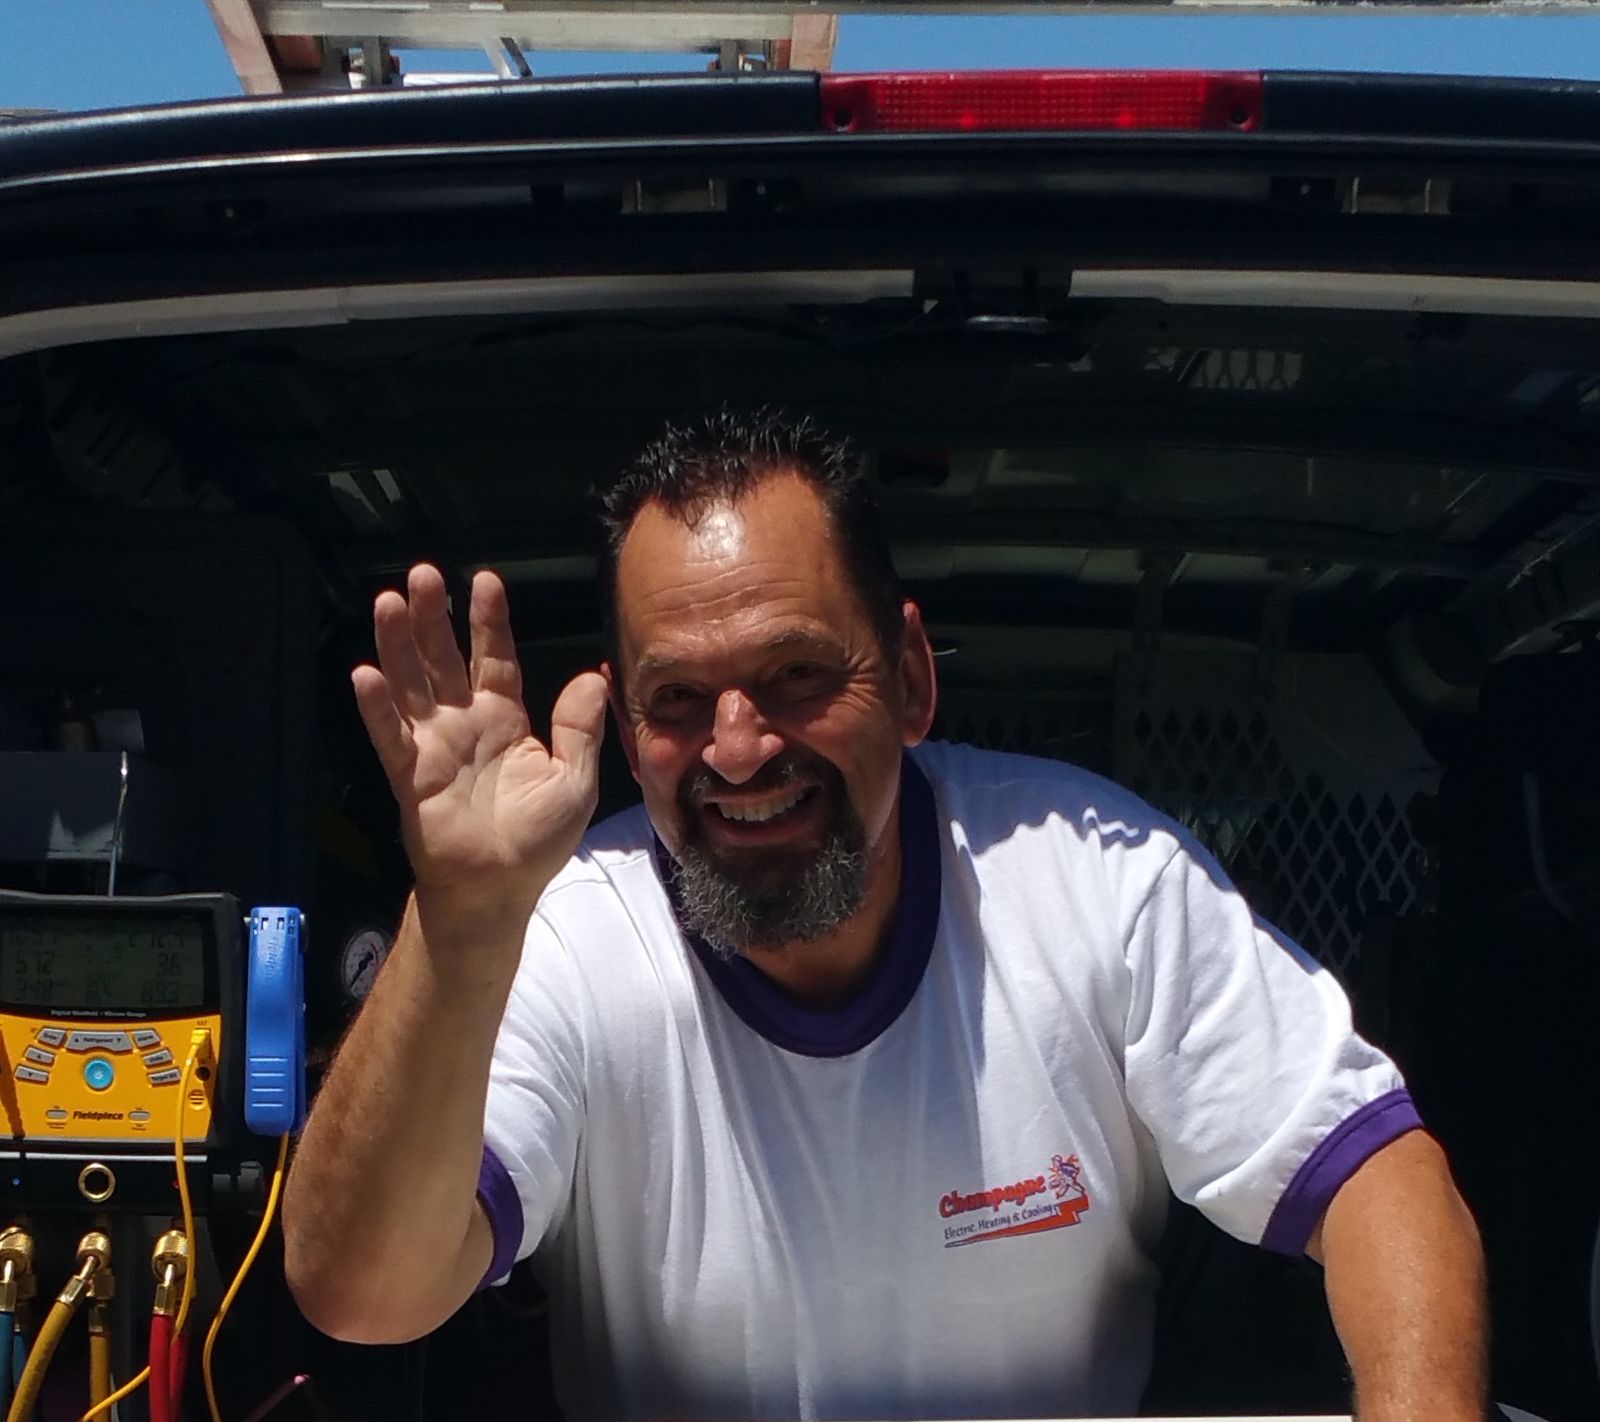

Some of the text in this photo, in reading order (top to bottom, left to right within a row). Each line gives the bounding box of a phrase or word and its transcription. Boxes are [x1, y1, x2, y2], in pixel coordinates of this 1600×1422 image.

[72, 1110, 124, 1121] Fieldpiece
[939, 1175, 1047, 1218] Champagne
[978, 1215, 1011, 1231] Heating
[1012, 1212, 1020, 1222] &
[1021, 1204, 1053, 1220] Cooling
